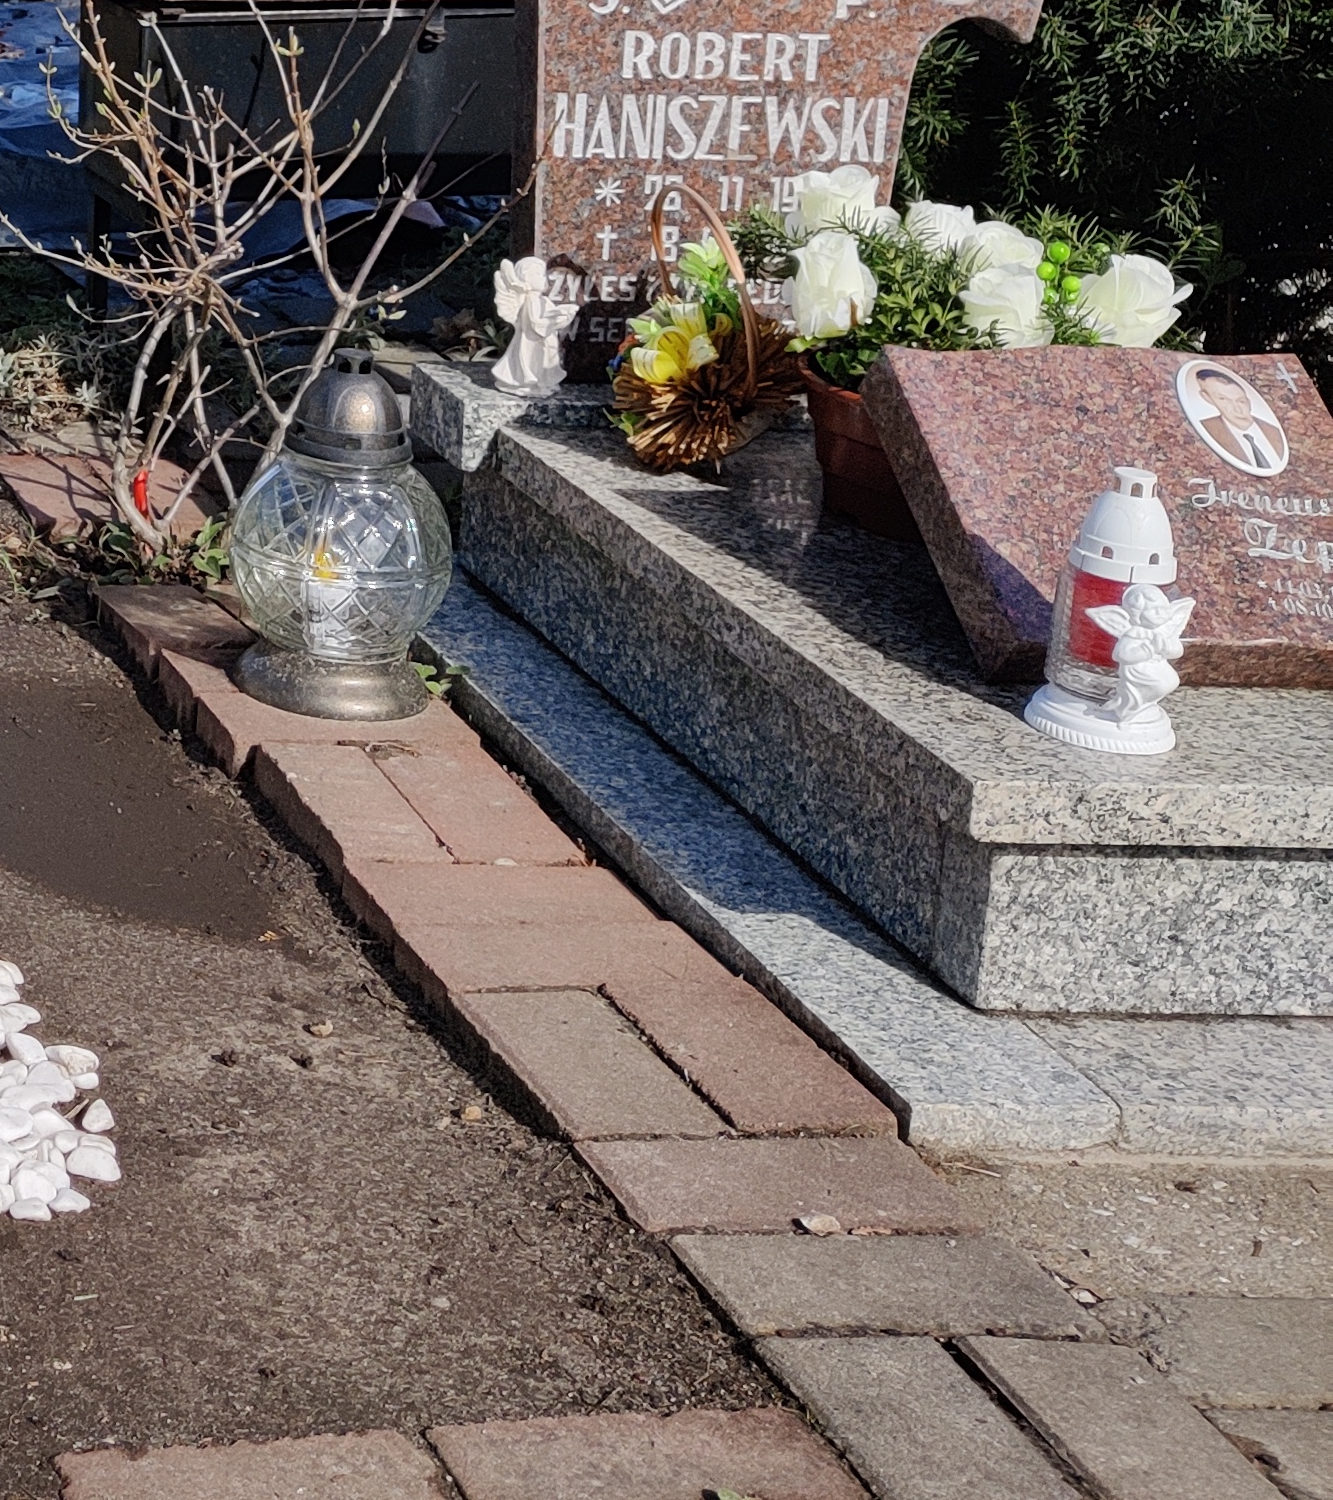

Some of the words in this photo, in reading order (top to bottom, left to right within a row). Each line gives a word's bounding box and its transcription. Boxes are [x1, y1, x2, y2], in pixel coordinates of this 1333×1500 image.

[621, 30, 831, 82] ROBERT
[552, 92, 889, 164] HANISZEWSKI
[719, 175, 745, 213] 11
[770, 177, 800, 214] 19
